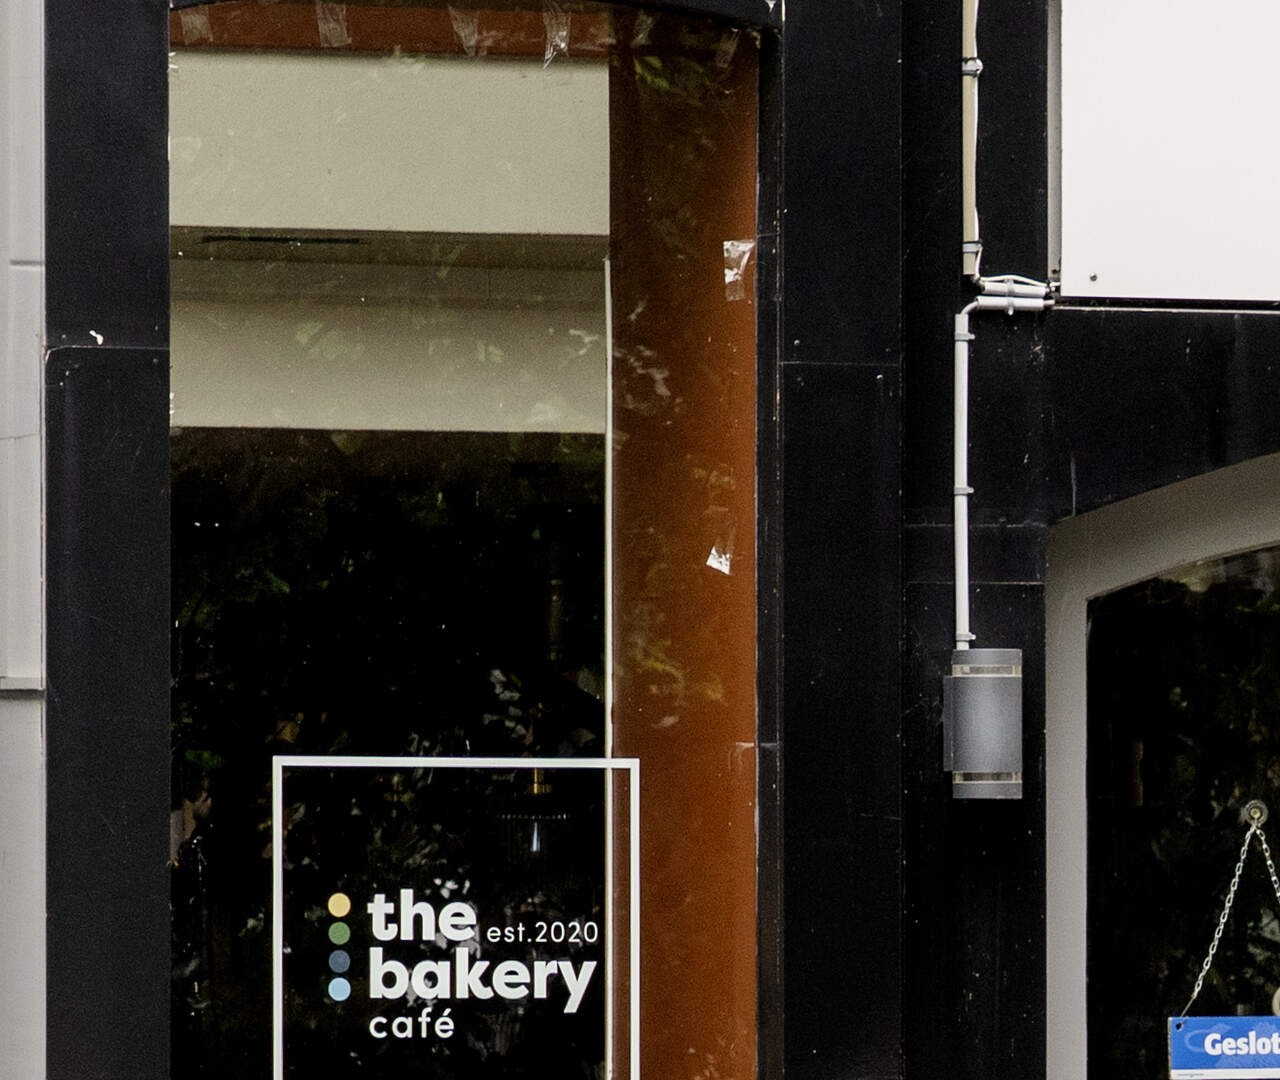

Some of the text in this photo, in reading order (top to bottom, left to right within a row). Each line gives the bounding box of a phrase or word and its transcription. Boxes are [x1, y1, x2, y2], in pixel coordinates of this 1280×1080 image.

[367, 888, 599, 943] the est.2020
[368, 947, 597, 1014] bakery
[369, 1008, 455, 1039] café
